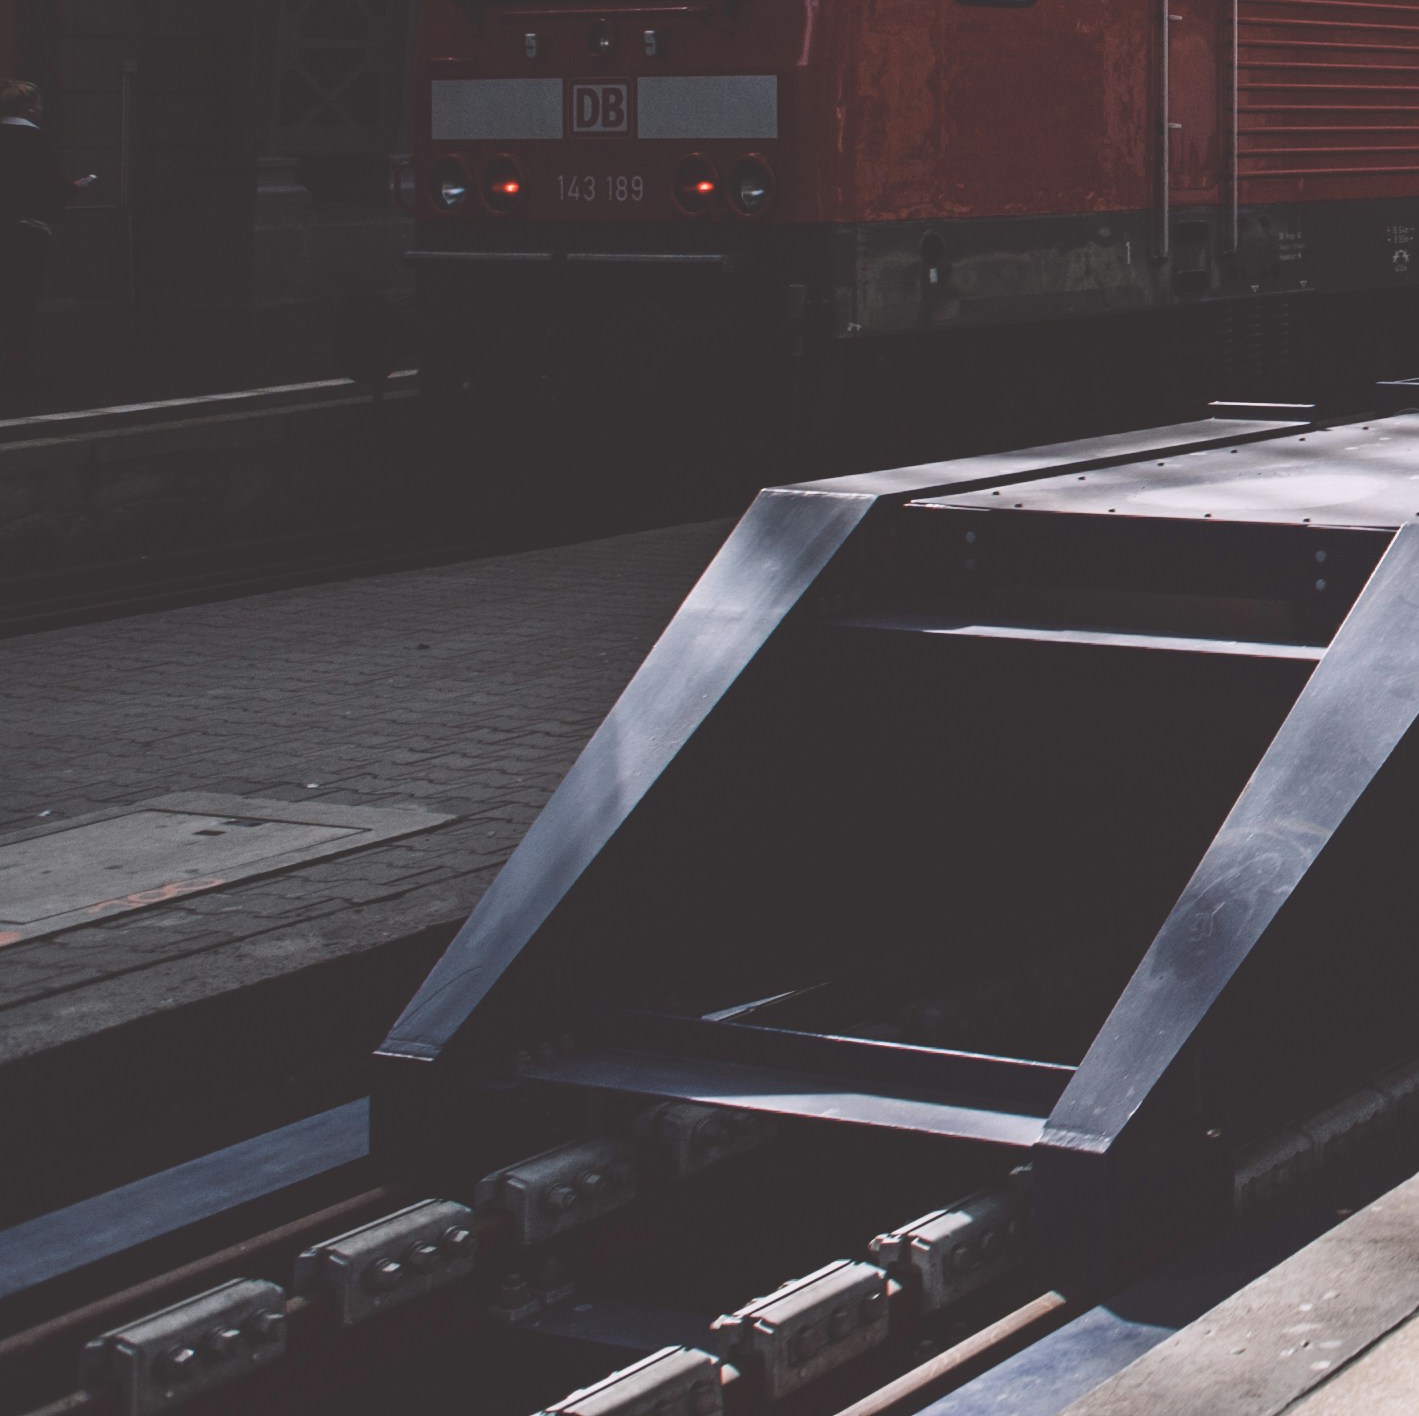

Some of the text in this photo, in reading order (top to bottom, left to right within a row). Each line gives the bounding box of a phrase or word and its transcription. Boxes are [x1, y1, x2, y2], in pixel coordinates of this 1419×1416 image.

[575, 86, 626, 130] DB
[557, 175, 644, 202] 143 189
